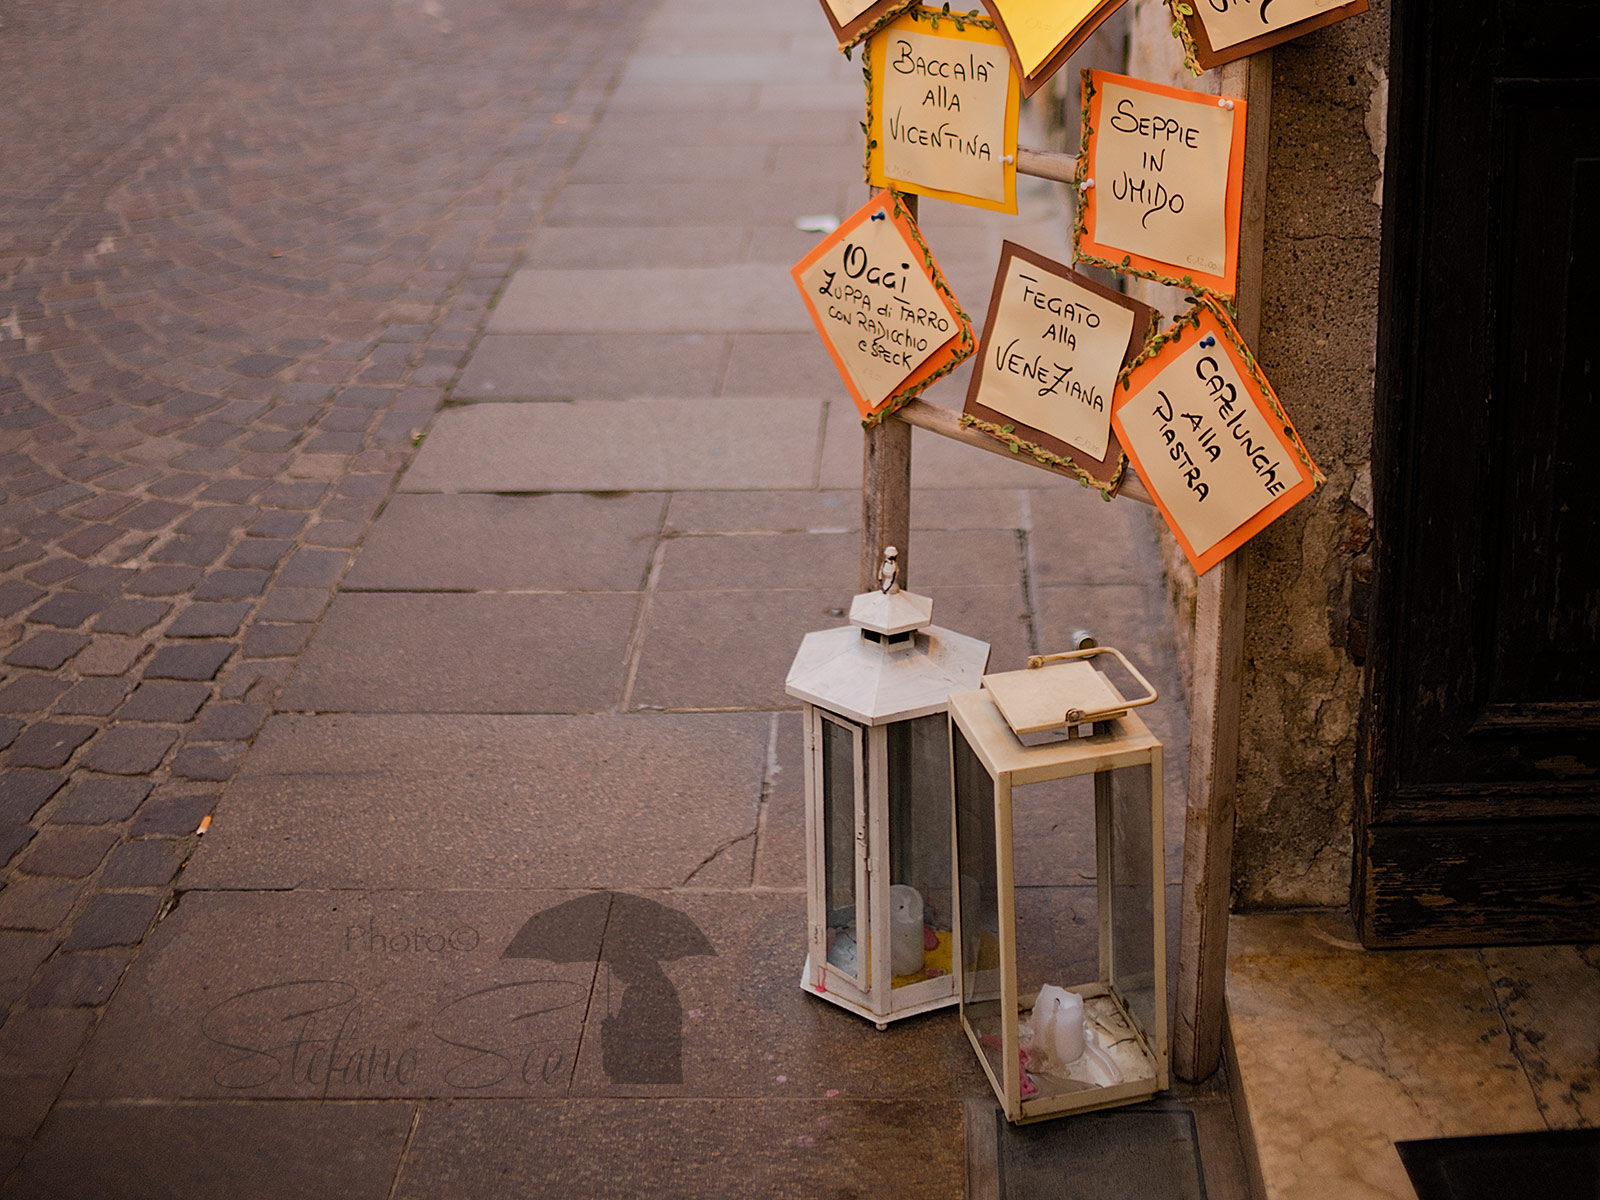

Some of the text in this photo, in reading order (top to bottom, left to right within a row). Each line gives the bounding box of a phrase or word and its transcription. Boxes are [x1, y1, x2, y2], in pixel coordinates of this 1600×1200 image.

[889, 106, 991, 161] VICENTINA
[1110, 99, 1200, 149] SEPPIE
[1143, 148, 1165, 172] IN
[1112, 171, 1184, 230] UMIDO
[818, 269, 871, 311] ZUPPA
[1019, 274, 1100, 328] FEGATO
[996, 338, 1104, 412] VENEZIANA
